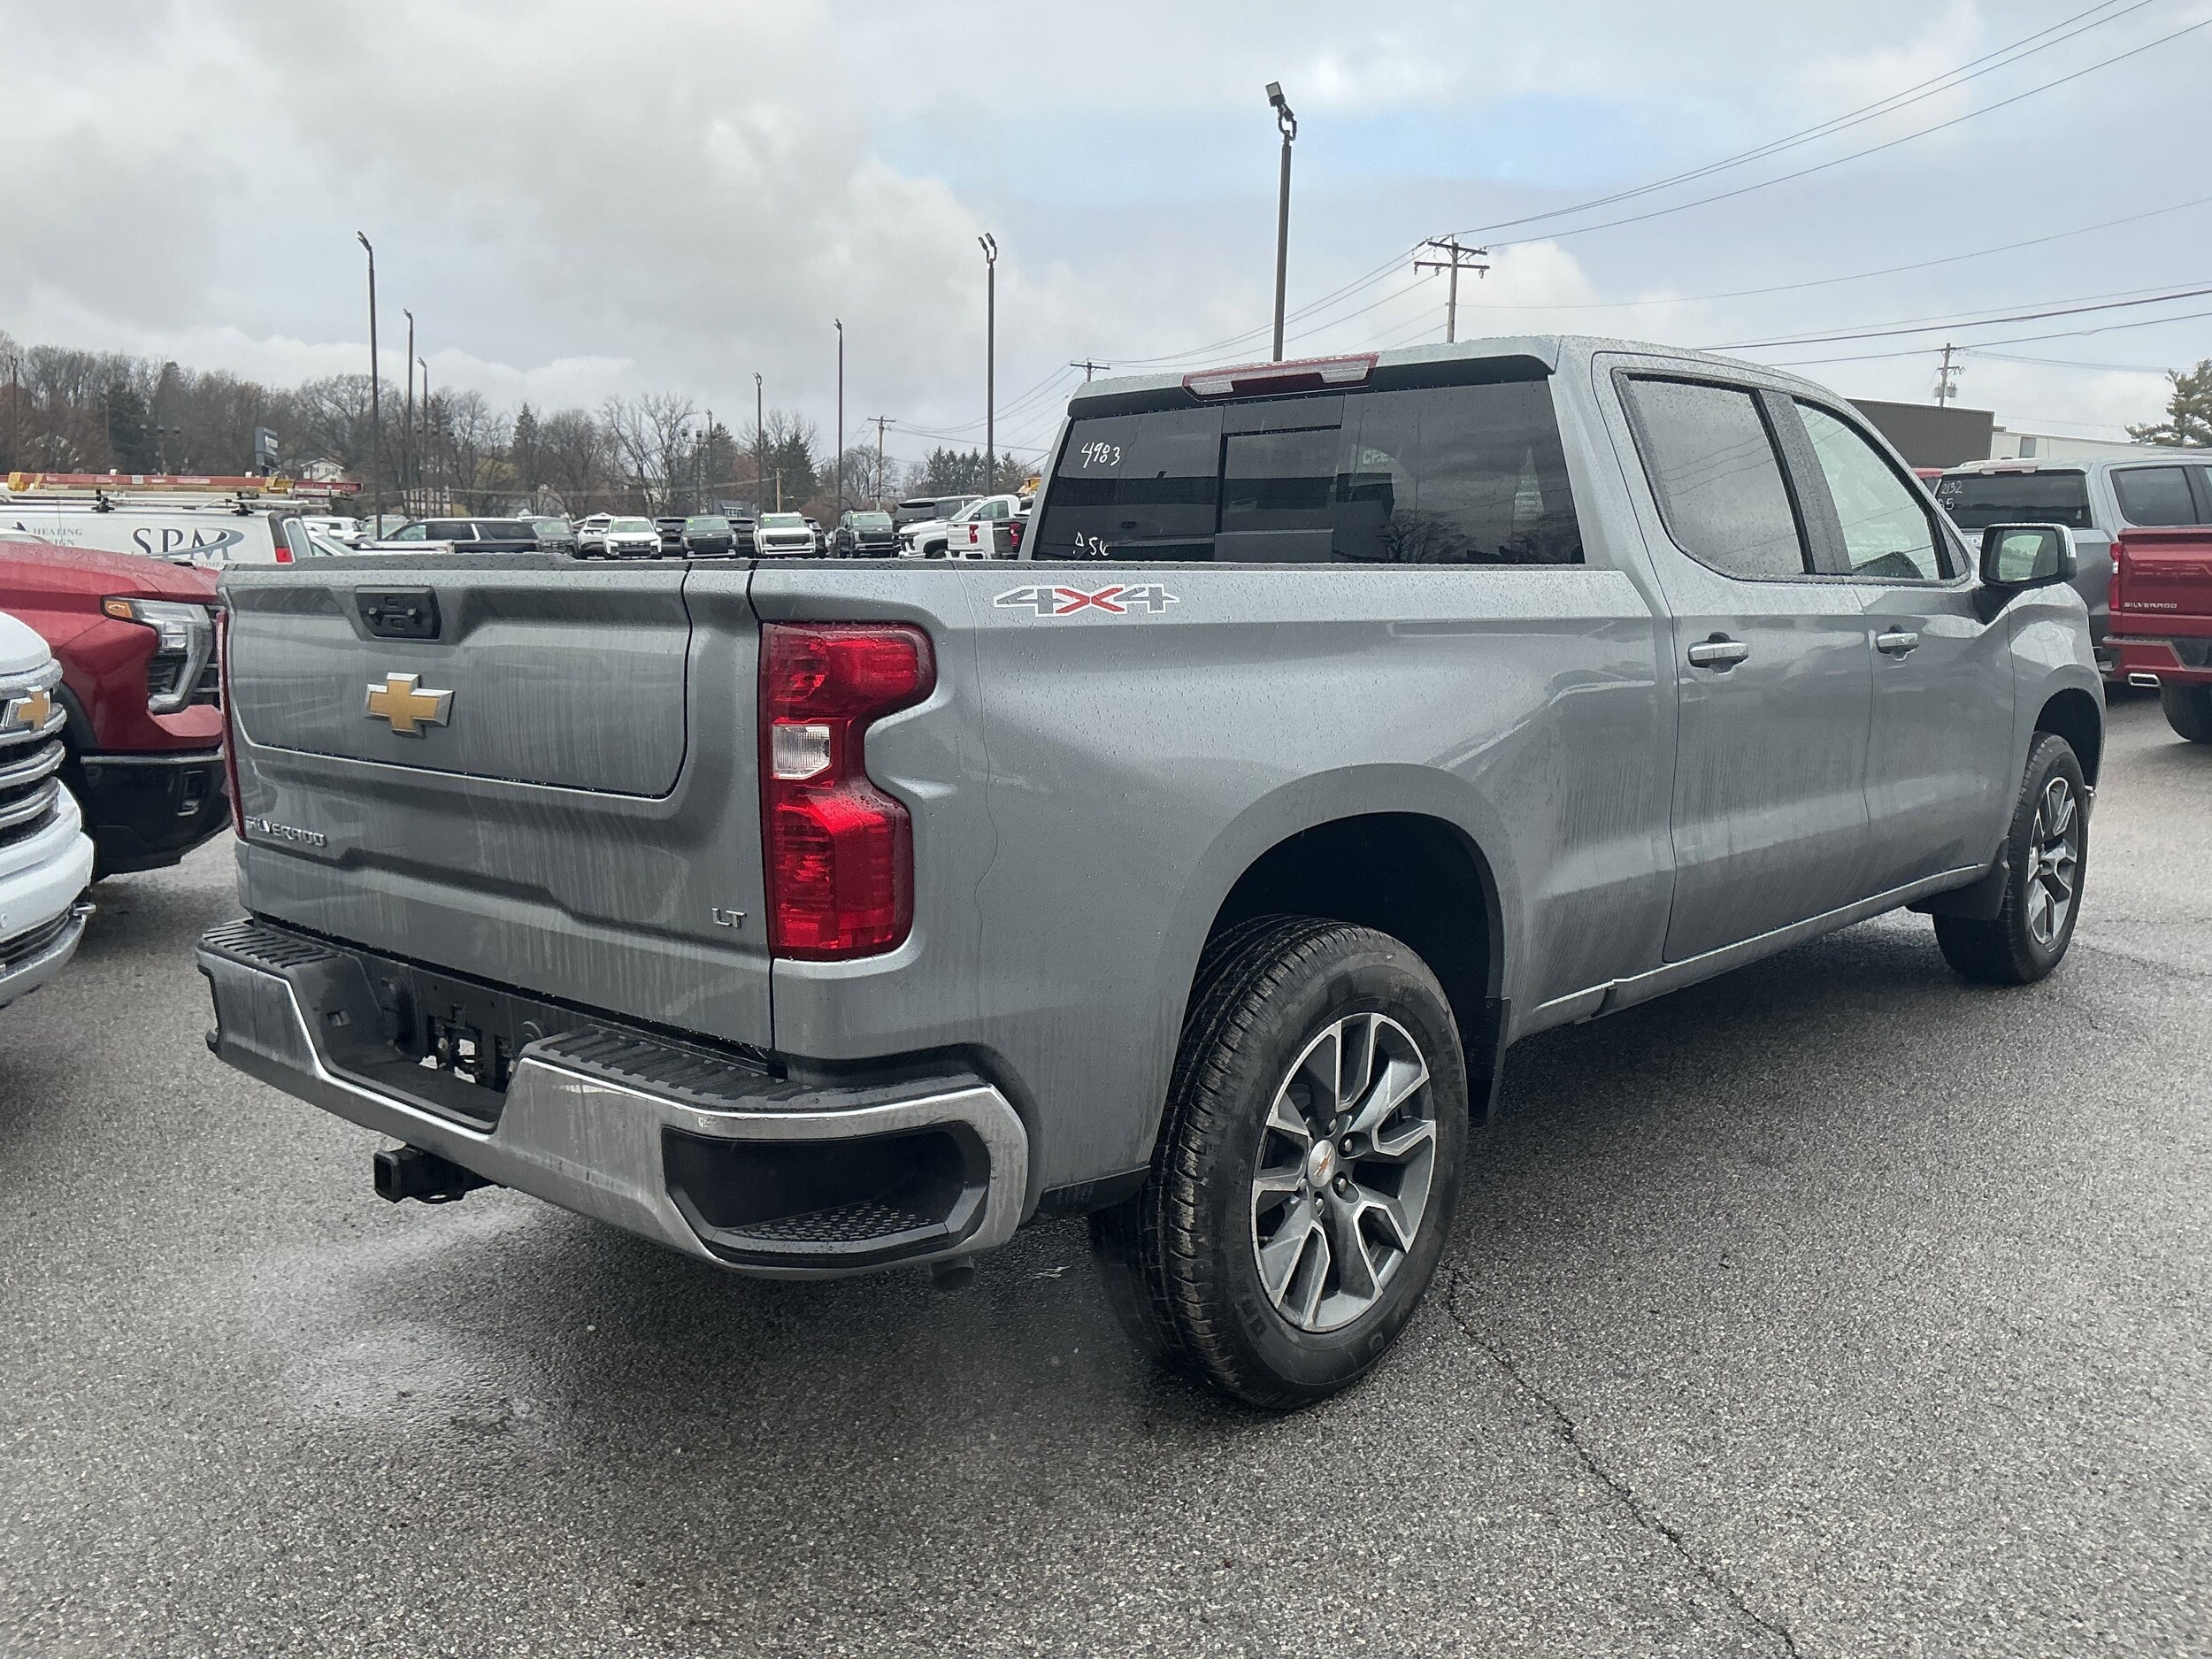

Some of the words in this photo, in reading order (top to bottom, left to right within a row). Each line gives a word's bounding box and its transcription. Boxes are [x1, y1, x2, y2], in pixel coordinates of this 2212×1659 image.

[1081, 442, 1120, 468] 4983
[1941, 480, 1962, 494] 2132
[711, 907, 746, 928] LT
